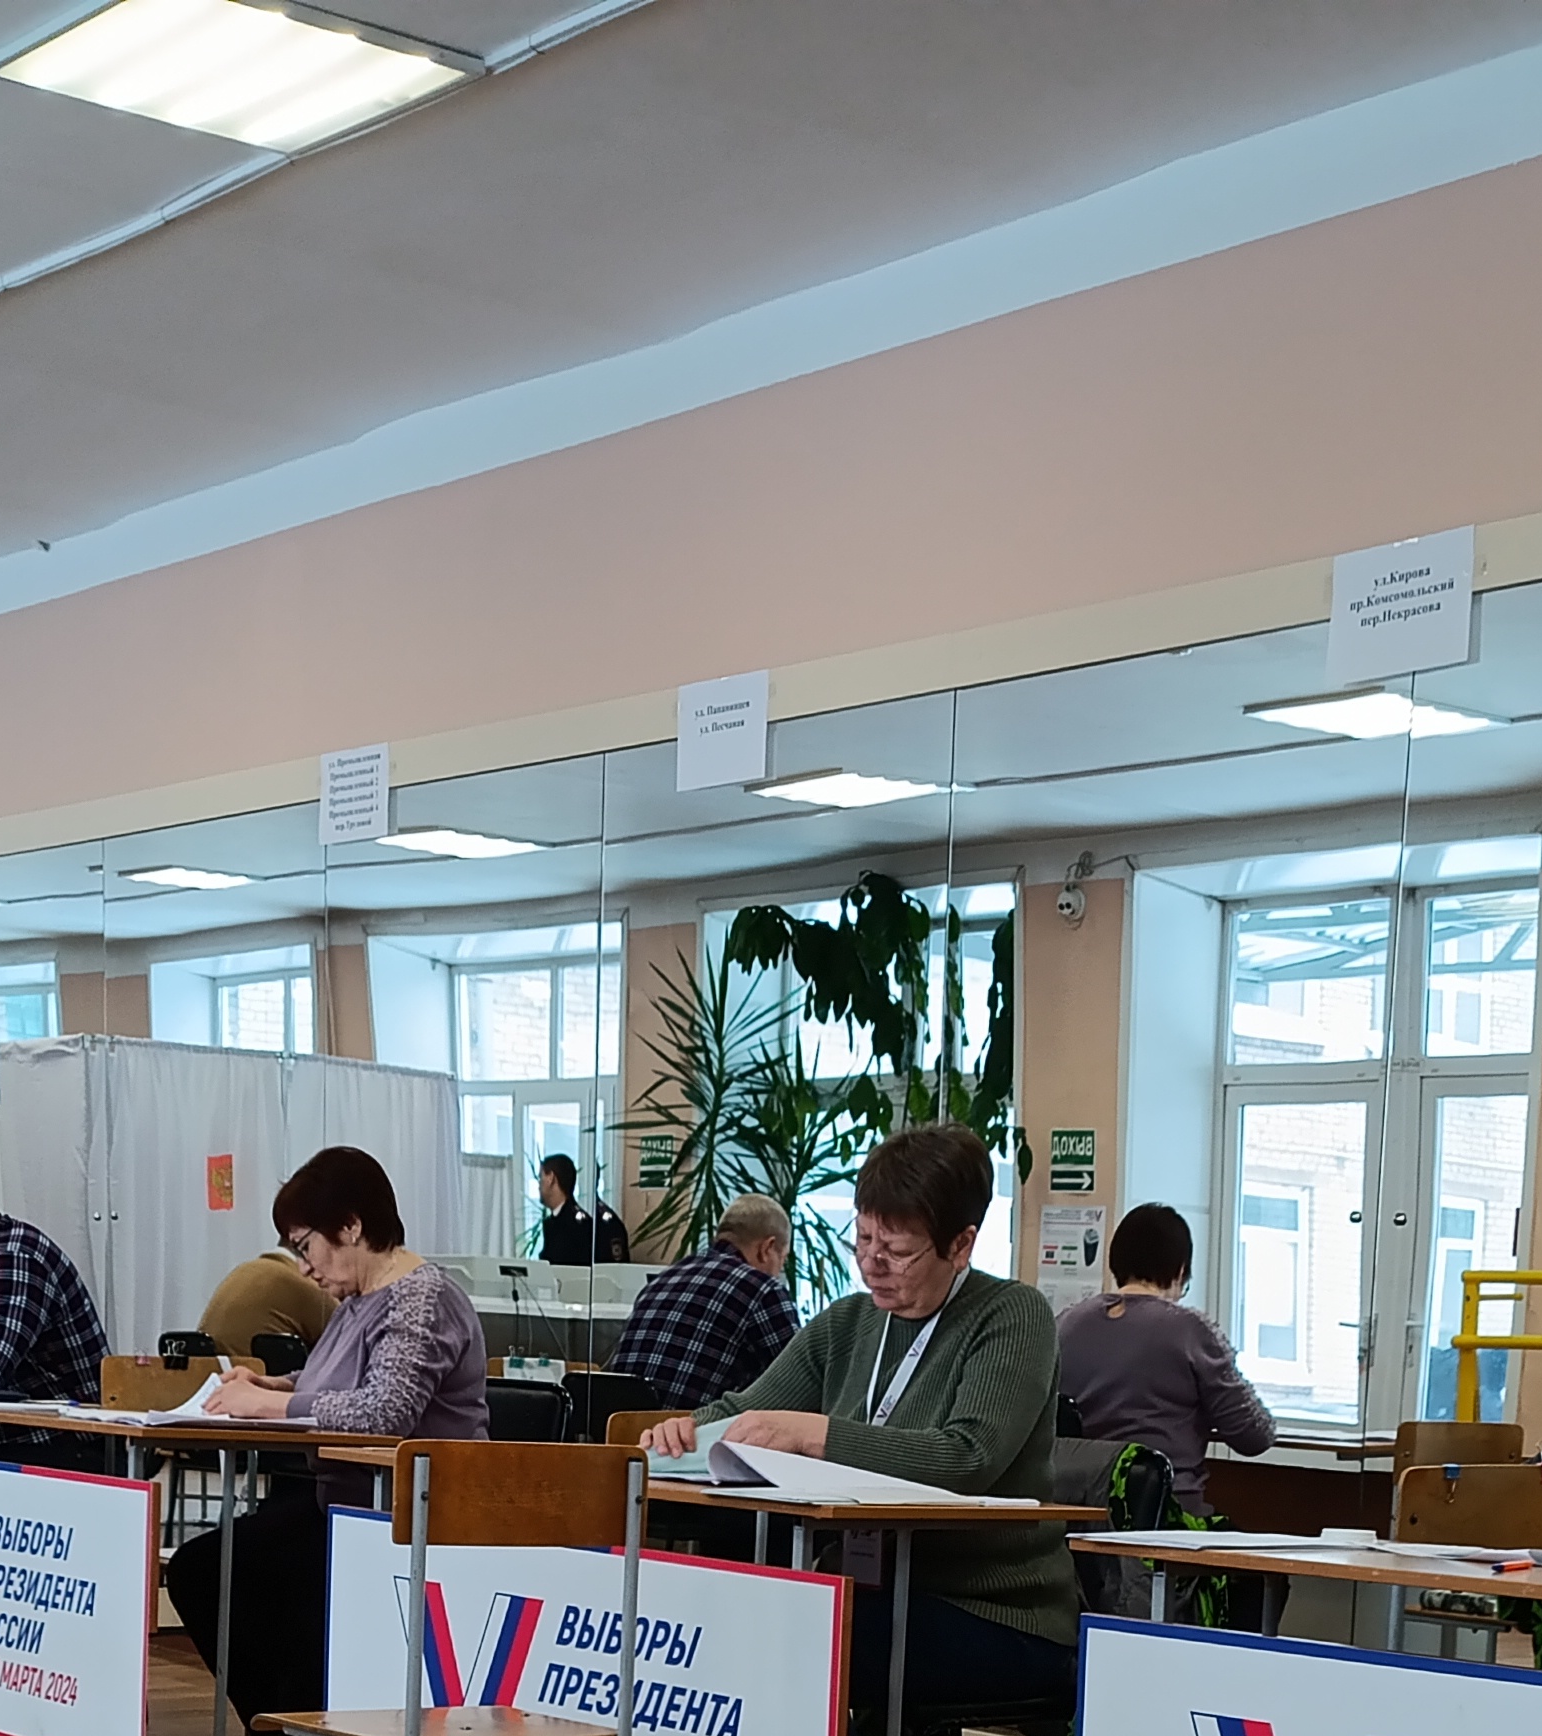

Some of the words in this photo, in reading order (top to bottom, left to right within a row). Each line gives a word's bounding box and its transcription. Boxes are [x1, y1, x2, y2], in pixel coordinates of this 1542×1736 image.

[1349, 577, 1455, 613] пр.Комсомольский
[1372, 566, 1431, 592] ул.Кирова
[1360, 601, 1442, 629] пер.Некрасова
[43, 1670, 78, 1707] 2024
